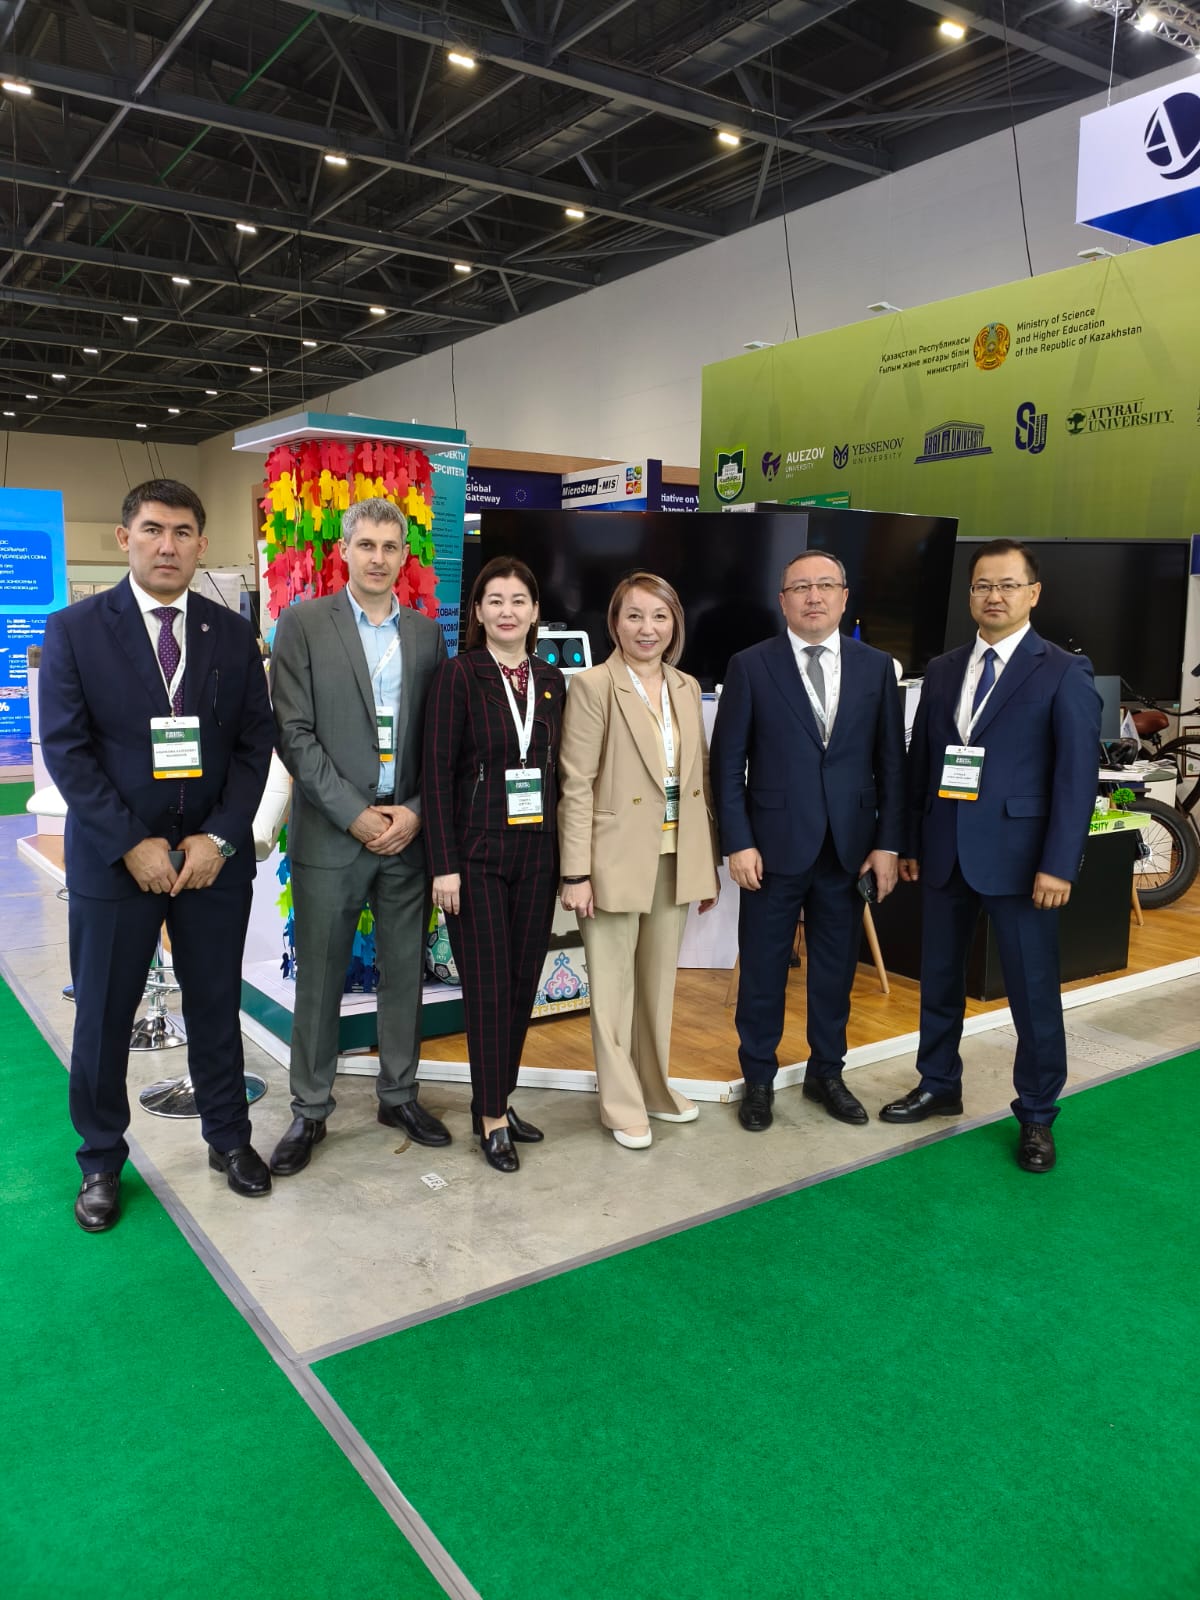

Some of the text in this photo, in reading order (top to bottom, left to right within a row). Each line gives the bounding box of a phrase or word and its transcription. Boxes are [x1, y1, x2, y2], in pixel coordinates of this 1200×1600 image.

[1016, 308, 1095, 331] Ministry of Science
[1016, 319, 1105, 344] and Higher Education
[919, 336, 971, 353] Республикасы
[1015, 325, 1142, 357] of the Republic of Kazakhstan
[1089, 402, 1143, 420] ATYRAU
[1088, 409, 1173, 432] UNIVERSITY
[852, 437, 904, 455] YESSENOV
[786, 447, 825, 464] AUEZOV
[853, 452, 902, 465] UNIVERSITY
[465, 484, 491, 493] Global
[465, 493, 501, 505] Gateway
